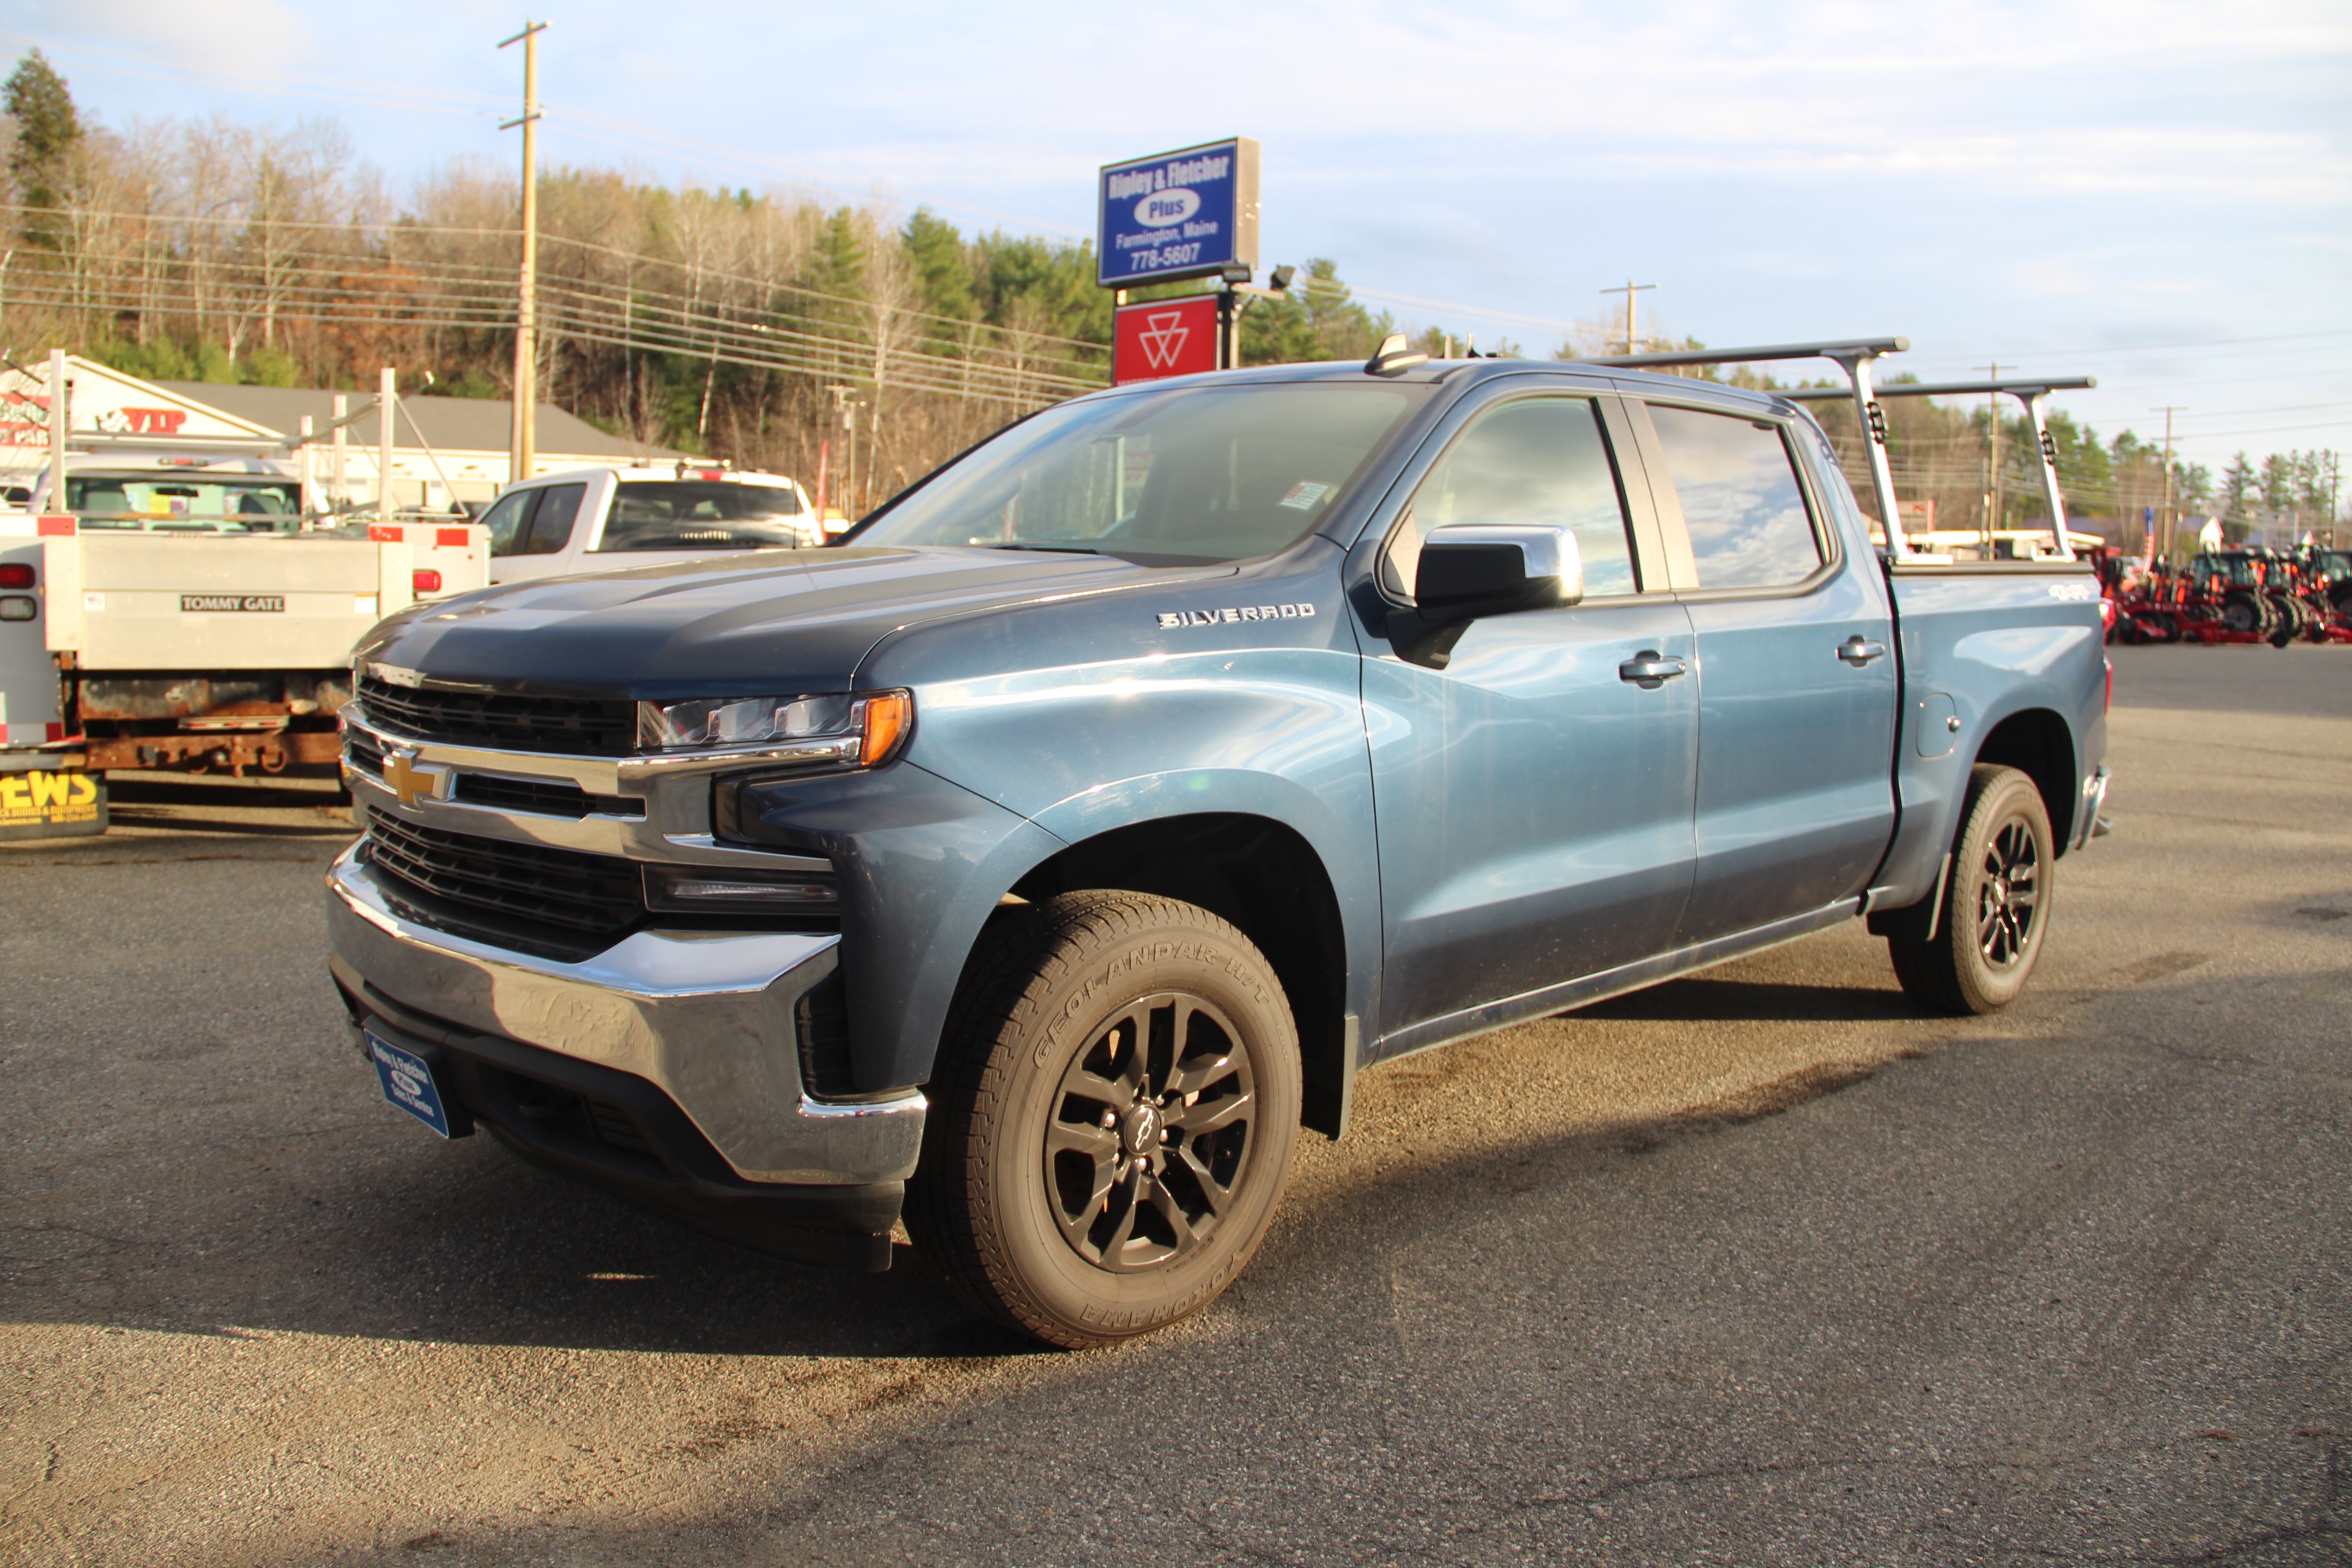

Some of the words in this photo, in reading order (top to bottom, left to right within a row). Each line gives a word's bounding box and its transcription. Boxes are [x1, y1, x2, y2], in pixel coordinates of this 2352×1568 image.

[1109, 171, 1153, 200] Ripley
[1155, 168, 1166, 190] &
[1167, 156, 1230, 187] Fletcher
[1148, 200, 1185, 219] Plus
[1115, 228, 1182, 249] Farmington,
[1183, 220, 1219, 238] Maine
[1130, 242, 1201, 271] 778-5607
[121, 407, 187, 434] VIP
[182, 596, 242, 610] TOMMY
[243, 596, 283, 611] GATE
[1156, 603, 1316, 630] SILVERADO
[0, 770, 97, 808] EWS
[1033, 940, 1218, 1069] GEOLANDAR
[1225, 956, 1270, 1004] H/T
[1079, 1249, 1244, 1327] YOKOHAMA
